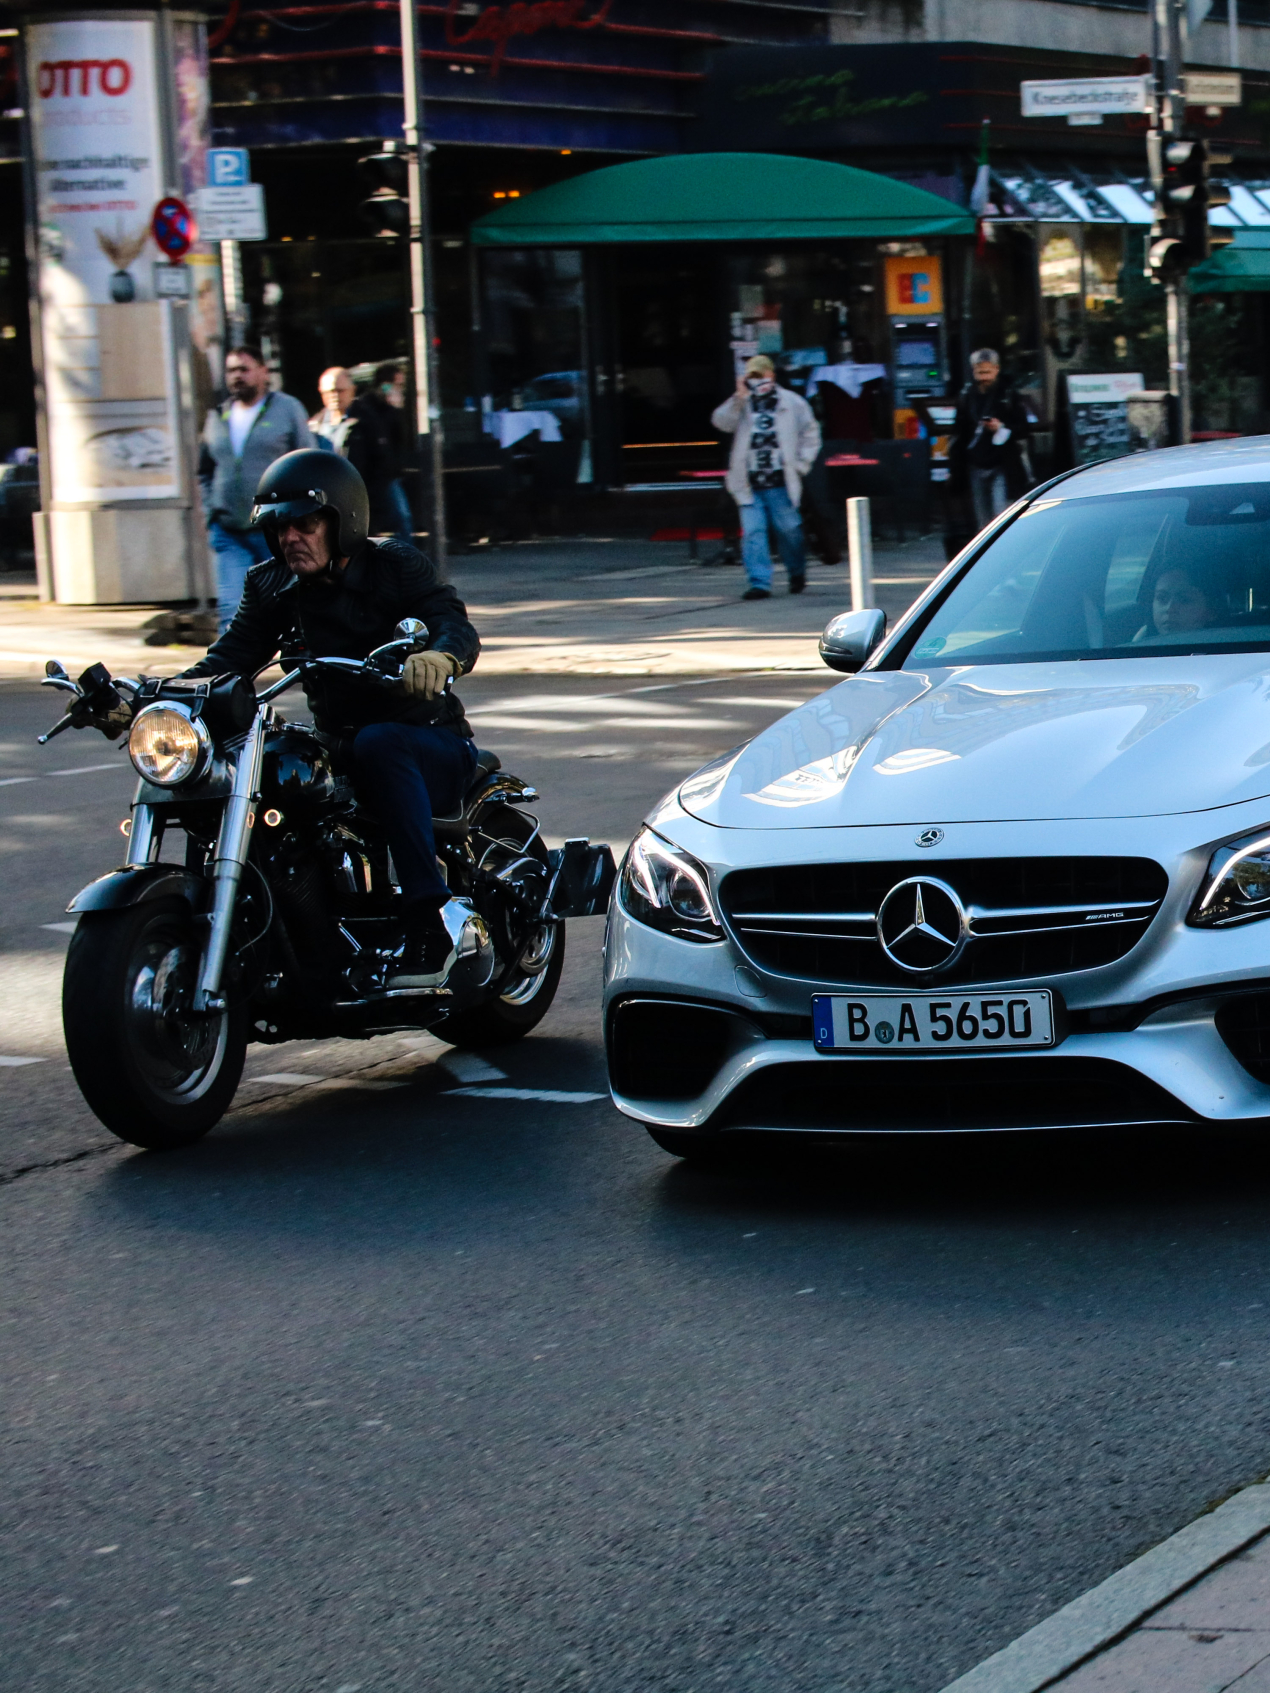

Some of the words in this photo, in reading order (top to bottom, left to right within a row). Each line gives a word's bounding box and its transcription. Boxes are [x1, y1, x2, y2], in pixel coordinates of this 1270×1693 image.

[39, 58, 131, 97] OTTO
[215, 153, 240, 183] P
[1099, 911, 1124, 919] AMG
[820, 1027, 828, 1039] D
[847, 1002, 871, 1042] B
[898, 1002, 921, 1042] A
[929, 998, 1032, 1042] 5650
